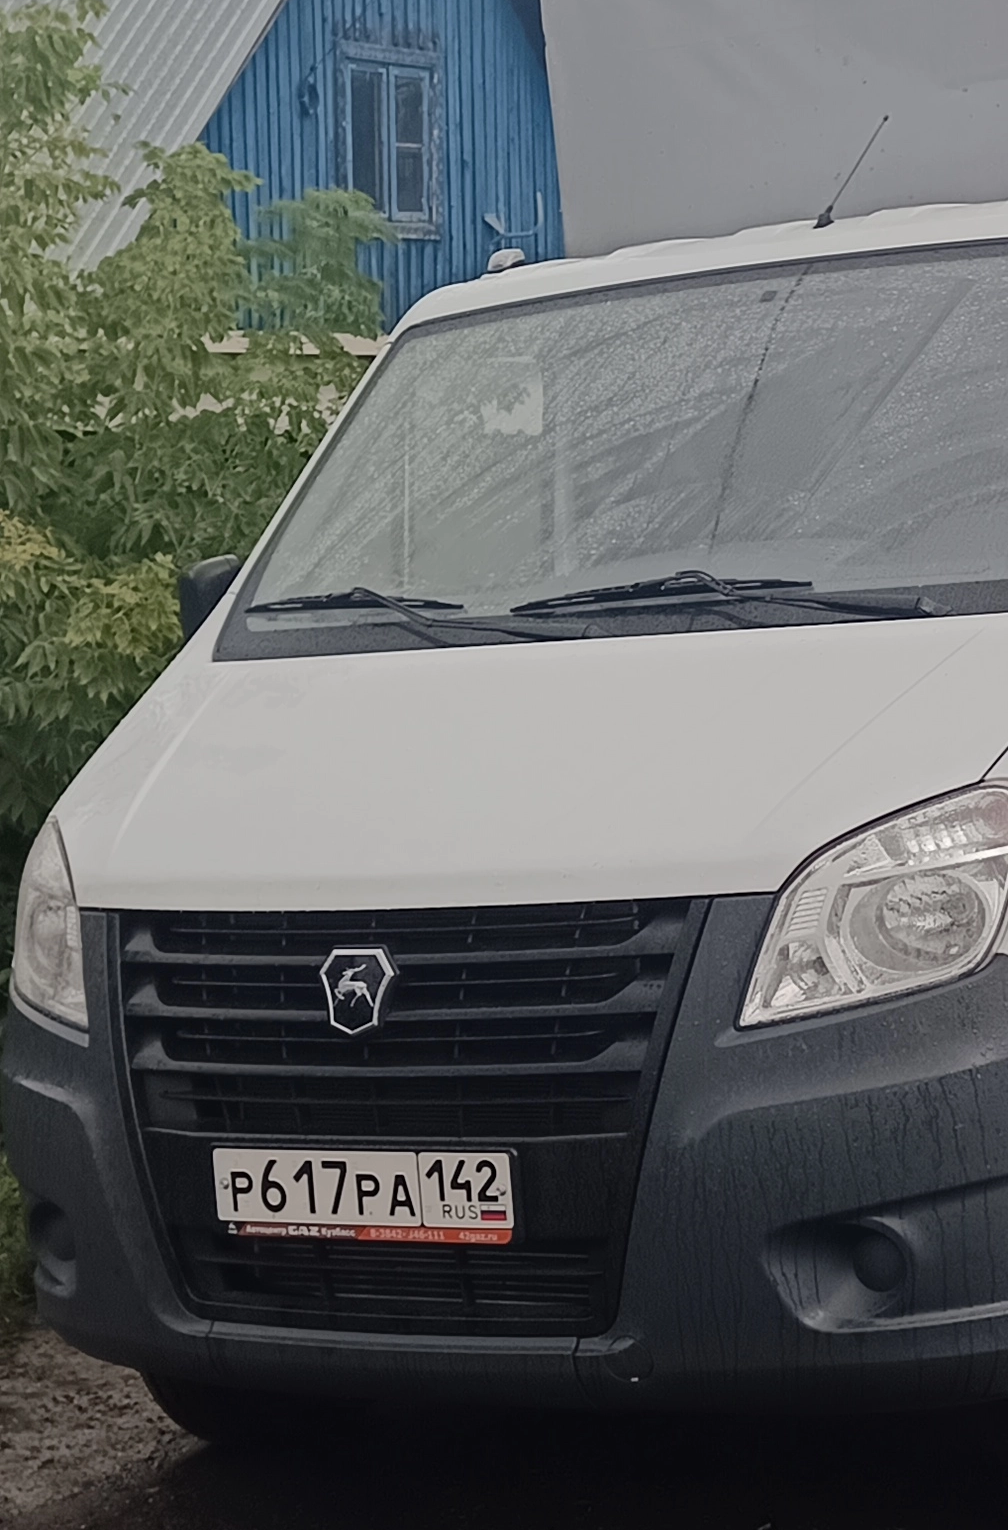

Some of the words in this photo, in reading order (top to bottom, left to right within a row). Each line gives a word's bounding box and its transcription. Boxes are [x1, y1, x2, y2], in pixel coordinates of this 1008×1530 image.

[425, 1159, 499, 1203] 142
[443, 1204, 479, 1220] RUS
[288, 1225, 320, 1236] GAZ
